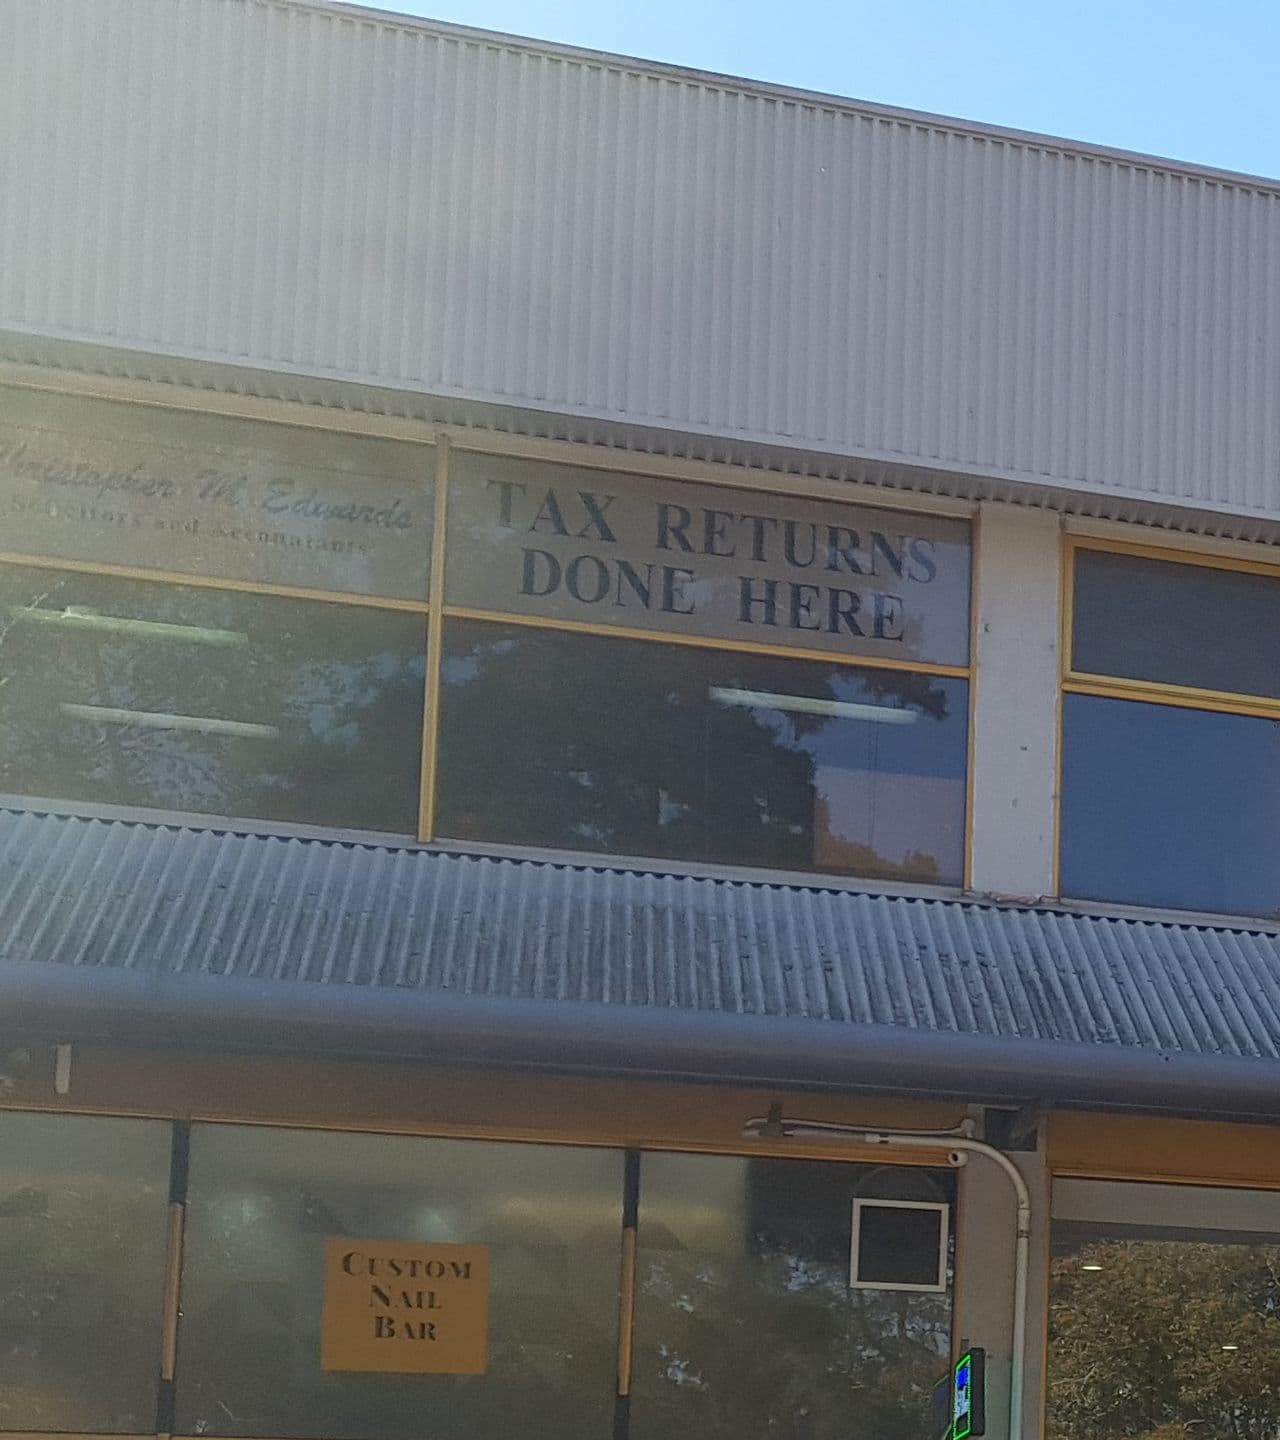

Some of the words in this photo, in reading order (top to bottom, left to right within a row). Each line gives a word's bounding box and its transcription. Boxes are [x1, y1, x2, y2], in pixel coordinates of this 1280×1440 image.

[487, 479, 617, 543] TAX
[656, 500, 938, 584] RETURNS
[520, 546, 697, 616] DONE
[736, 575, 905, 642] HERE
[374, 1315, 437, 1341] BAR
